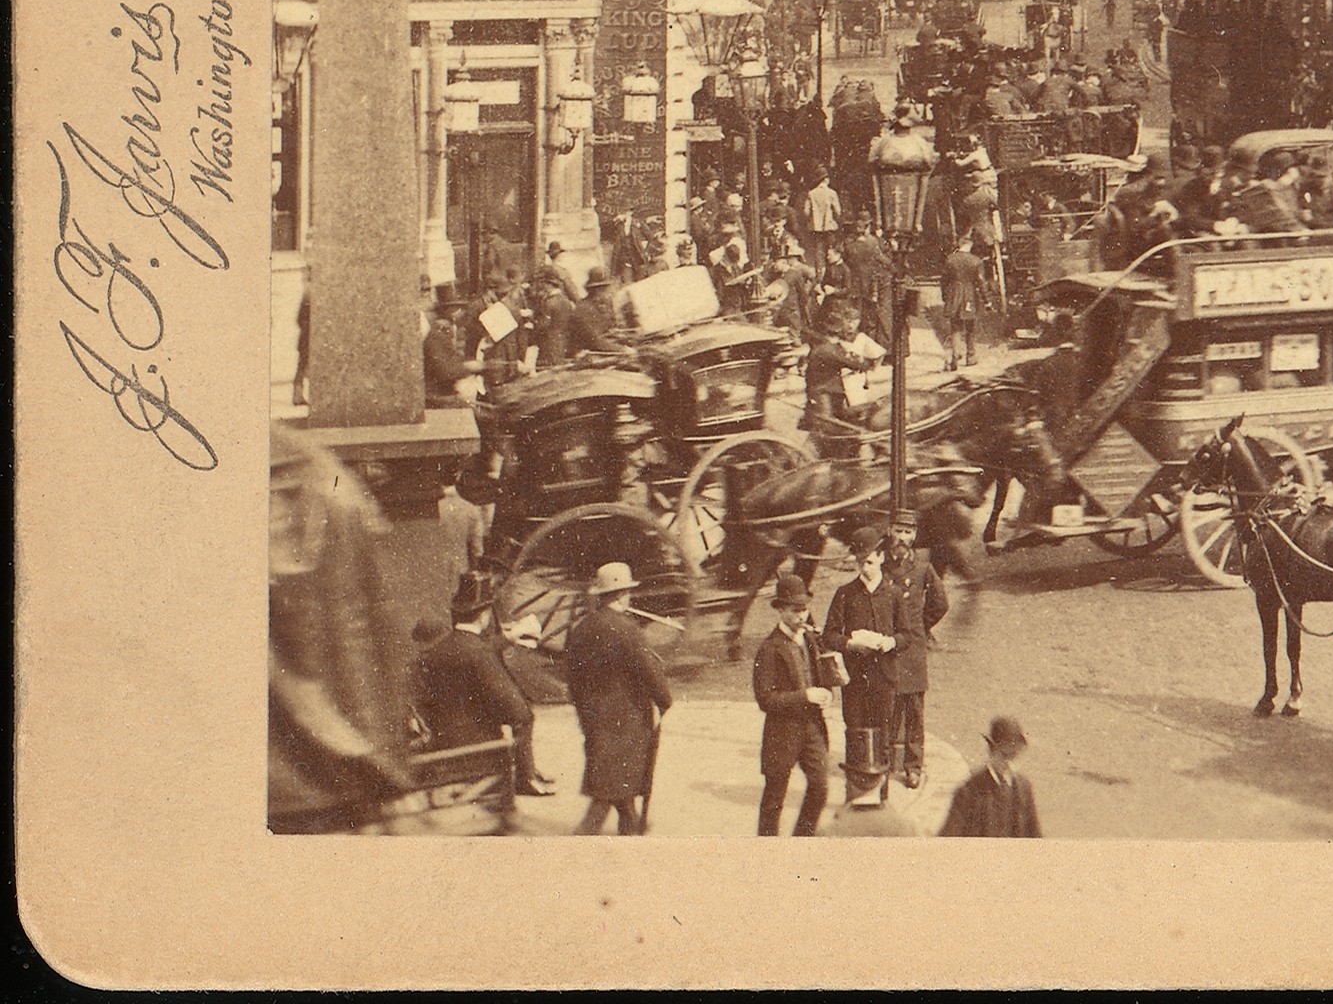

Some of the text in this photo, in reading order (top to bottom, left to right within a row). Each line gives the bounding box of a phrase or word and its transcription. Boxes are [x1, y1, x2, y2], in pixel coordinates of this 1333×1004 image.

[604, 11, 665, 28] KING
[595, 163, 664, 173] LUNCHEON
[607, 175, 646, 189] BAR
